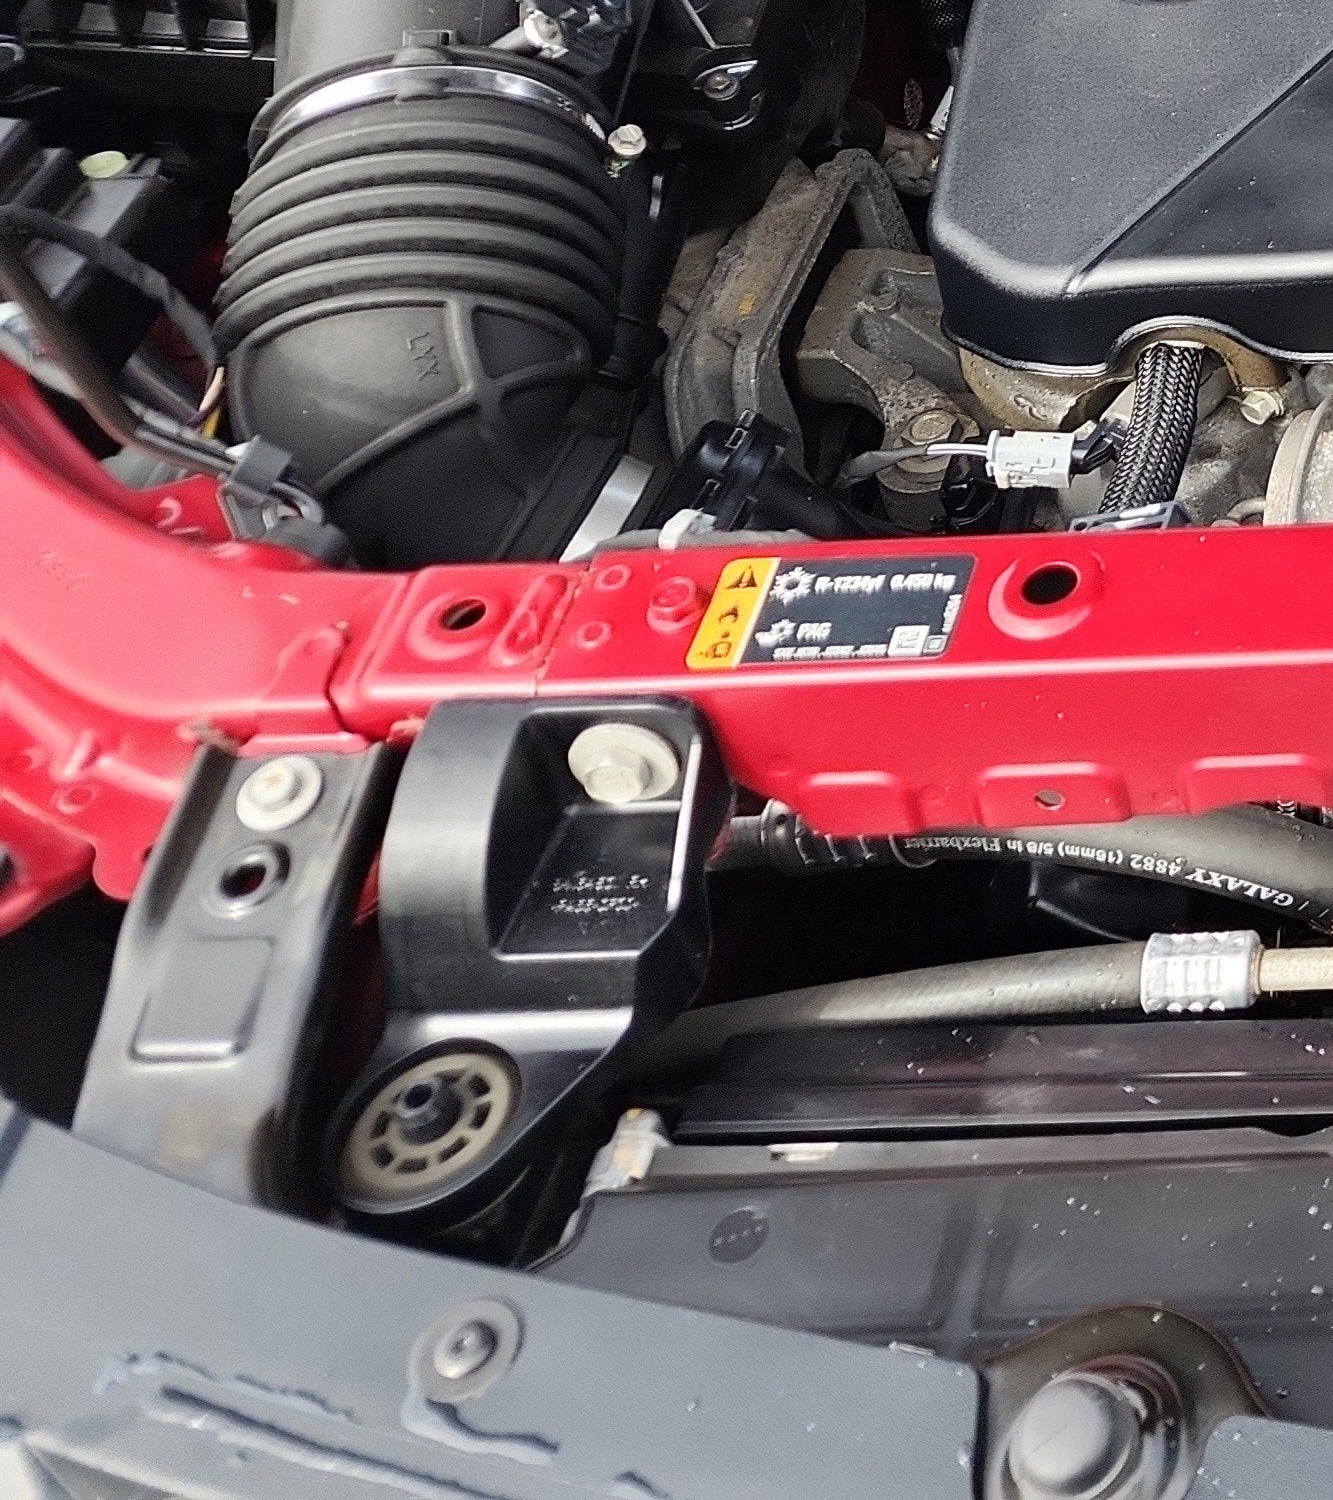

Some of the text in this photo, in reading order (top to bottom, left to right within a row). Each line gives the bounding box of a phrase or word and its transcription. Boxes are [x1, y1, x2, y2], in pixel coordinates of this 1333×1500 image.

[796, 622, 832, 641] PAG
[902, 834, 1294, 908] GALAXY 4882 (16mm) 5/8 in Flexbarrier
